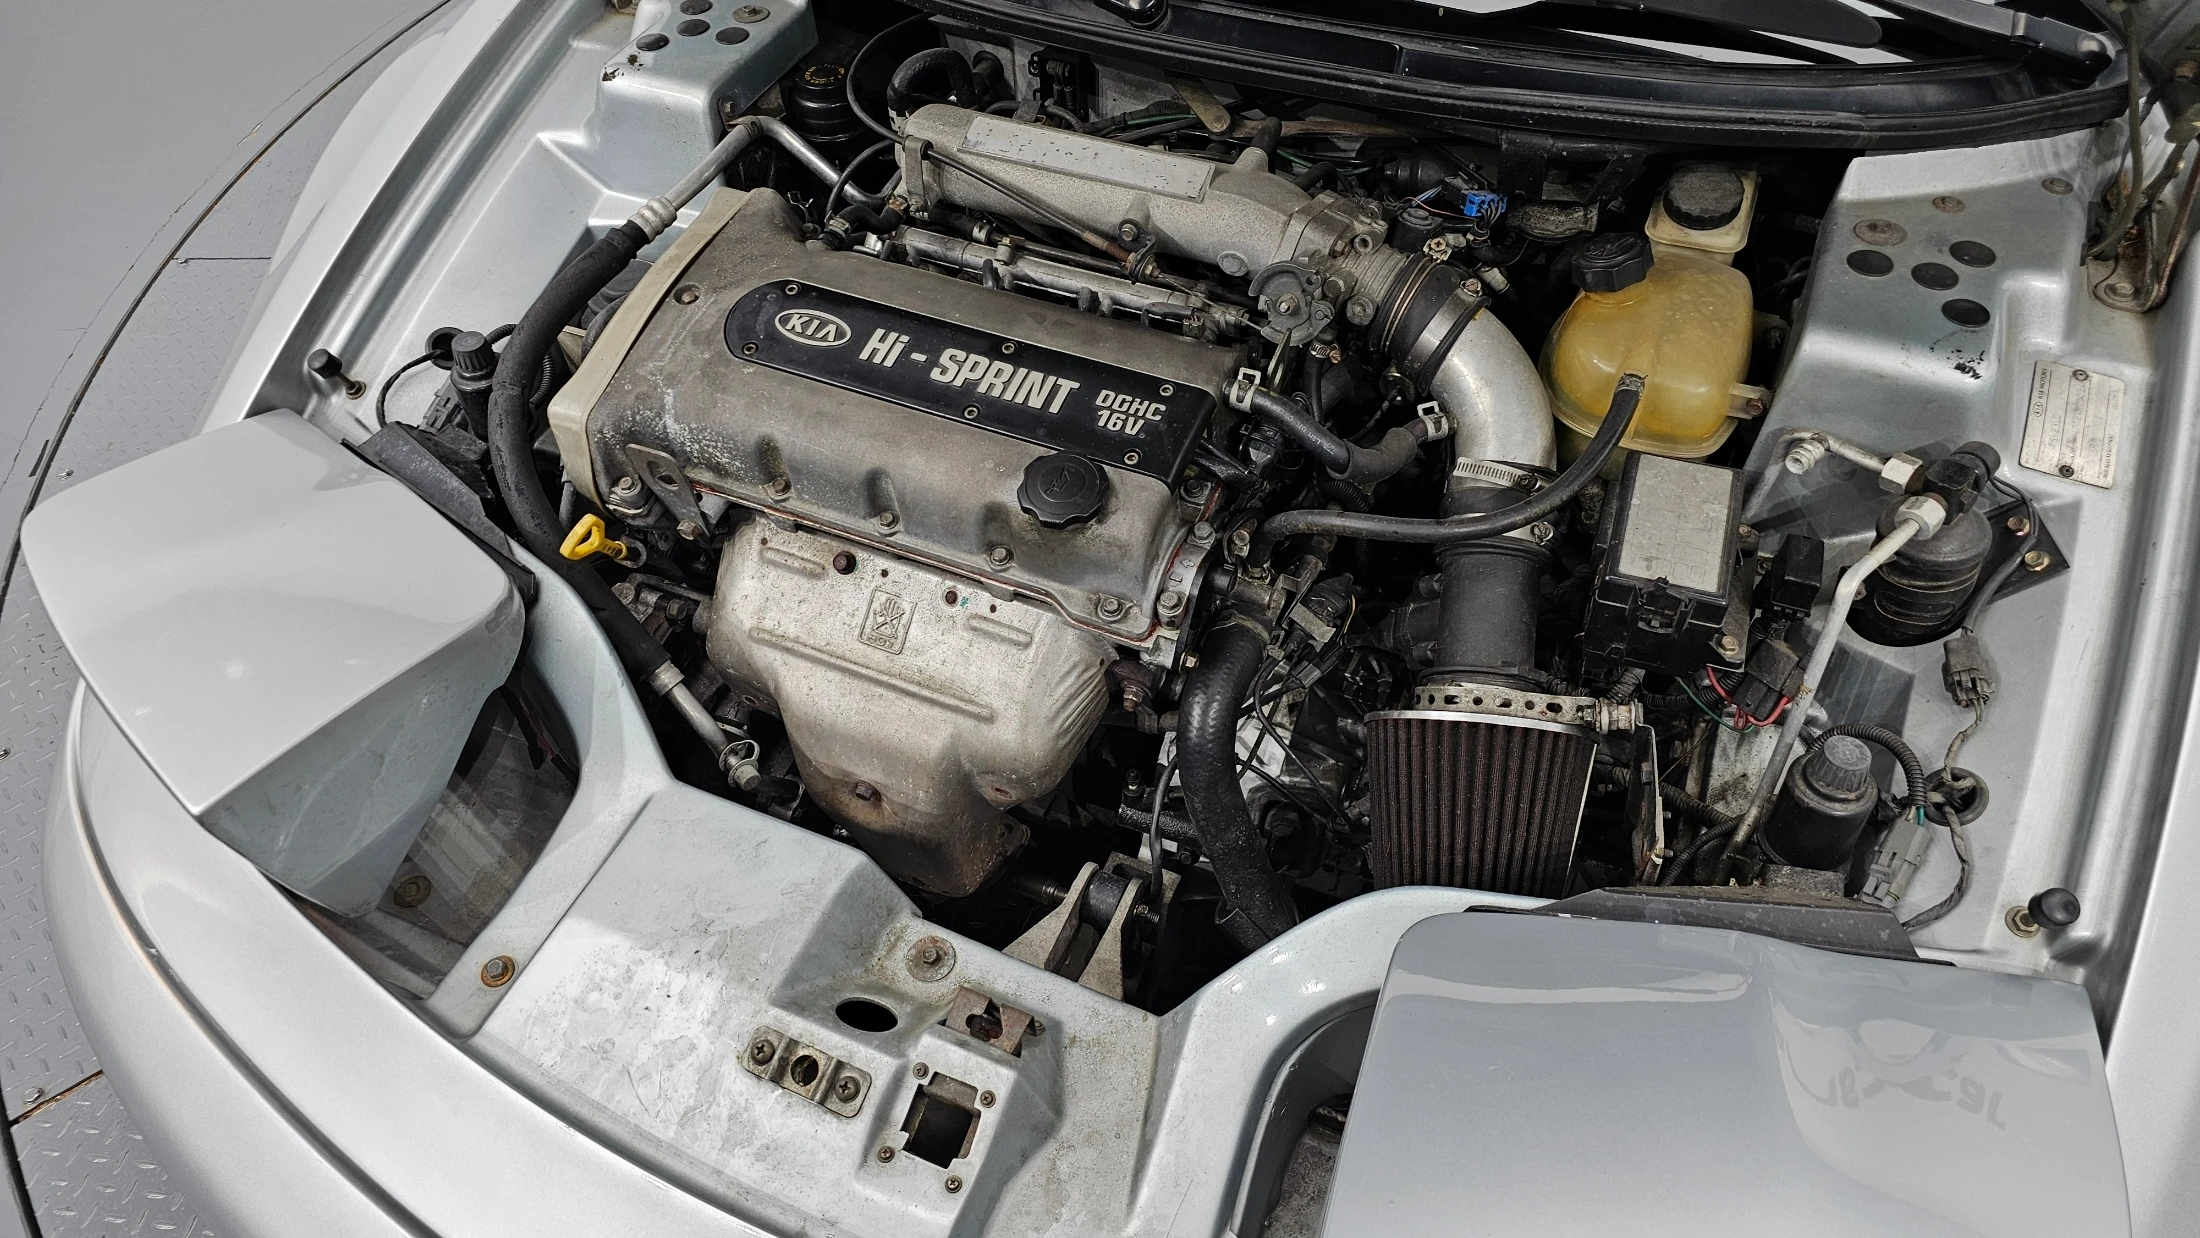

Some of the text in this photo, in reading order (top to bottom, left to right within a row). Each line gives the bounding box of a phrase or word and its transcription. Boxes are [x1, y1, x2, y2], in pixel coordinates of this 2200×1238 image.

[784, 313, 839, 342] KIA
[930, 348, 1081, 414] SPRINT
[1097, 409, 1146, 436] 16V
[866, 632, 895, 649] HOT
